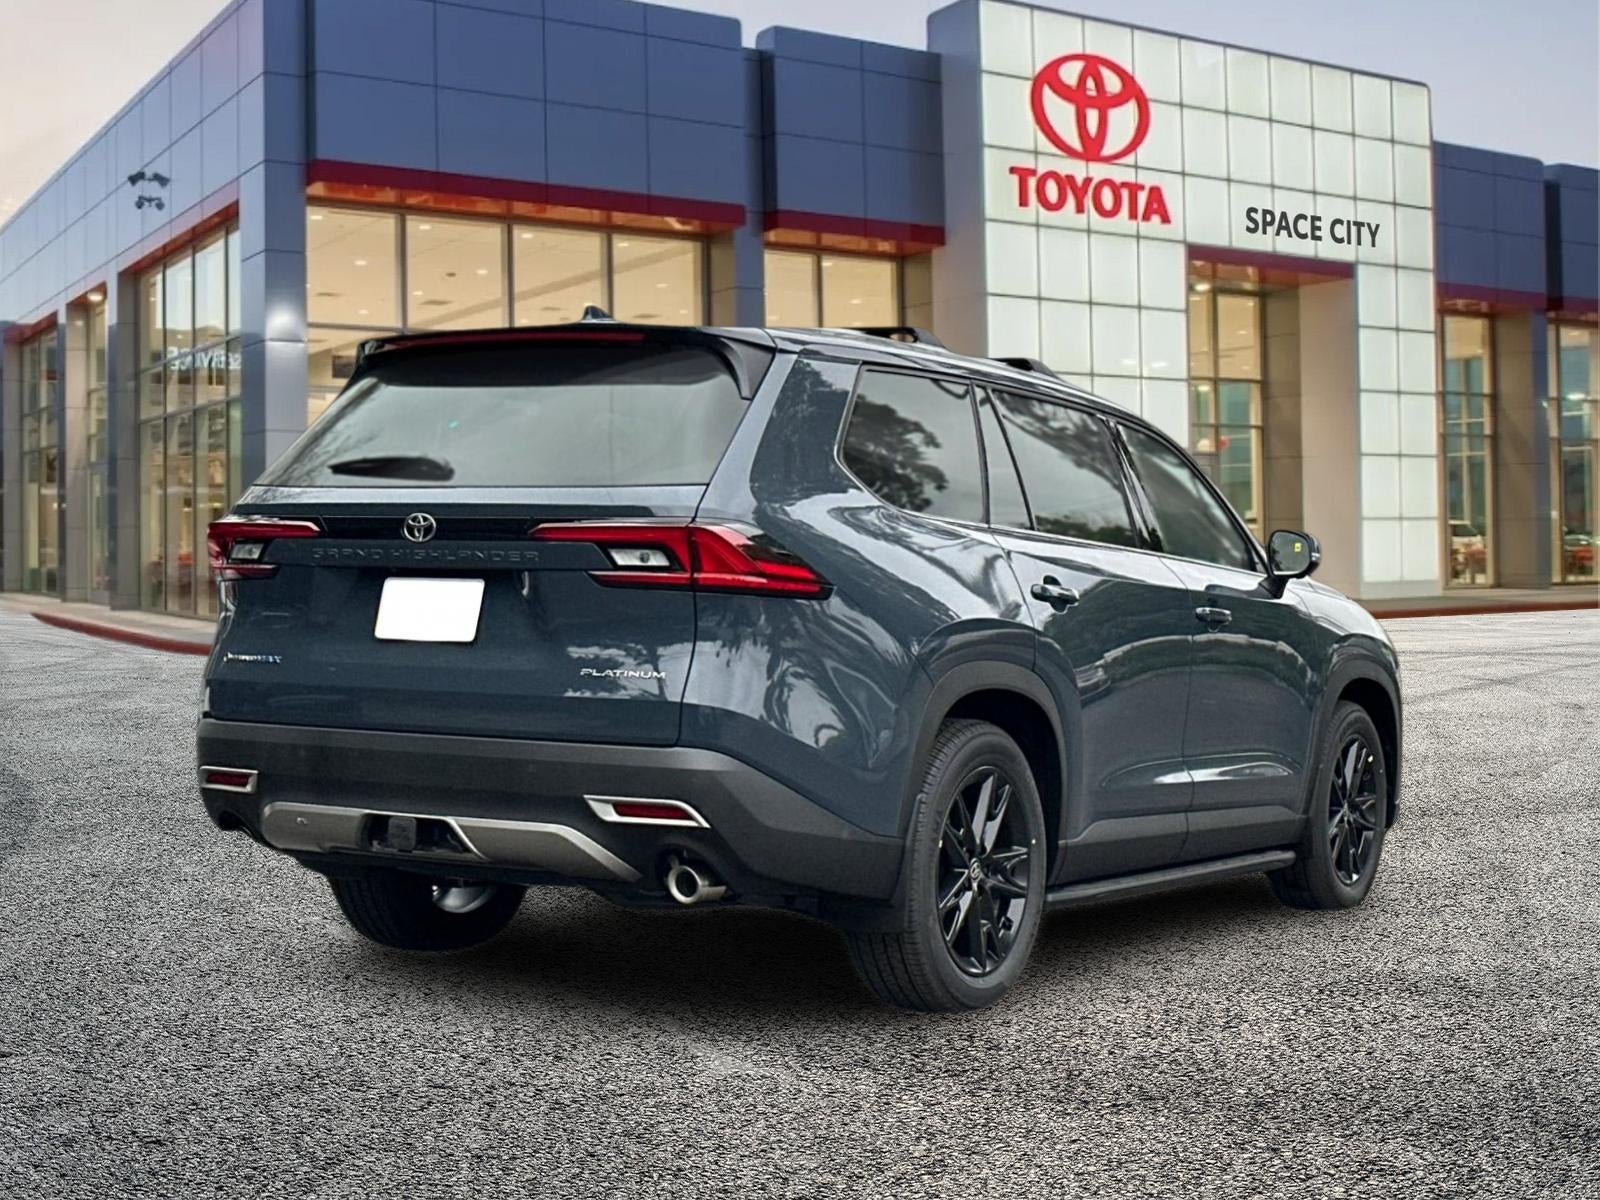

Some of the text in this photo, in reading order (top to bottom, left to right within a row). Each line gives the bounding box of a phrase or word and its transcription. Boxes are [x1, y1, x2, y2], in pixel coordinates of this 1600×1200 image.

[1009, 166, 1172, 224] TOYOTA
[1245, 206, 1381, 248] SPACE CITY
[312, 548, 540, 562] GRAND HIGHLANDER
[580, 667, 667, 680] PLATINUM
